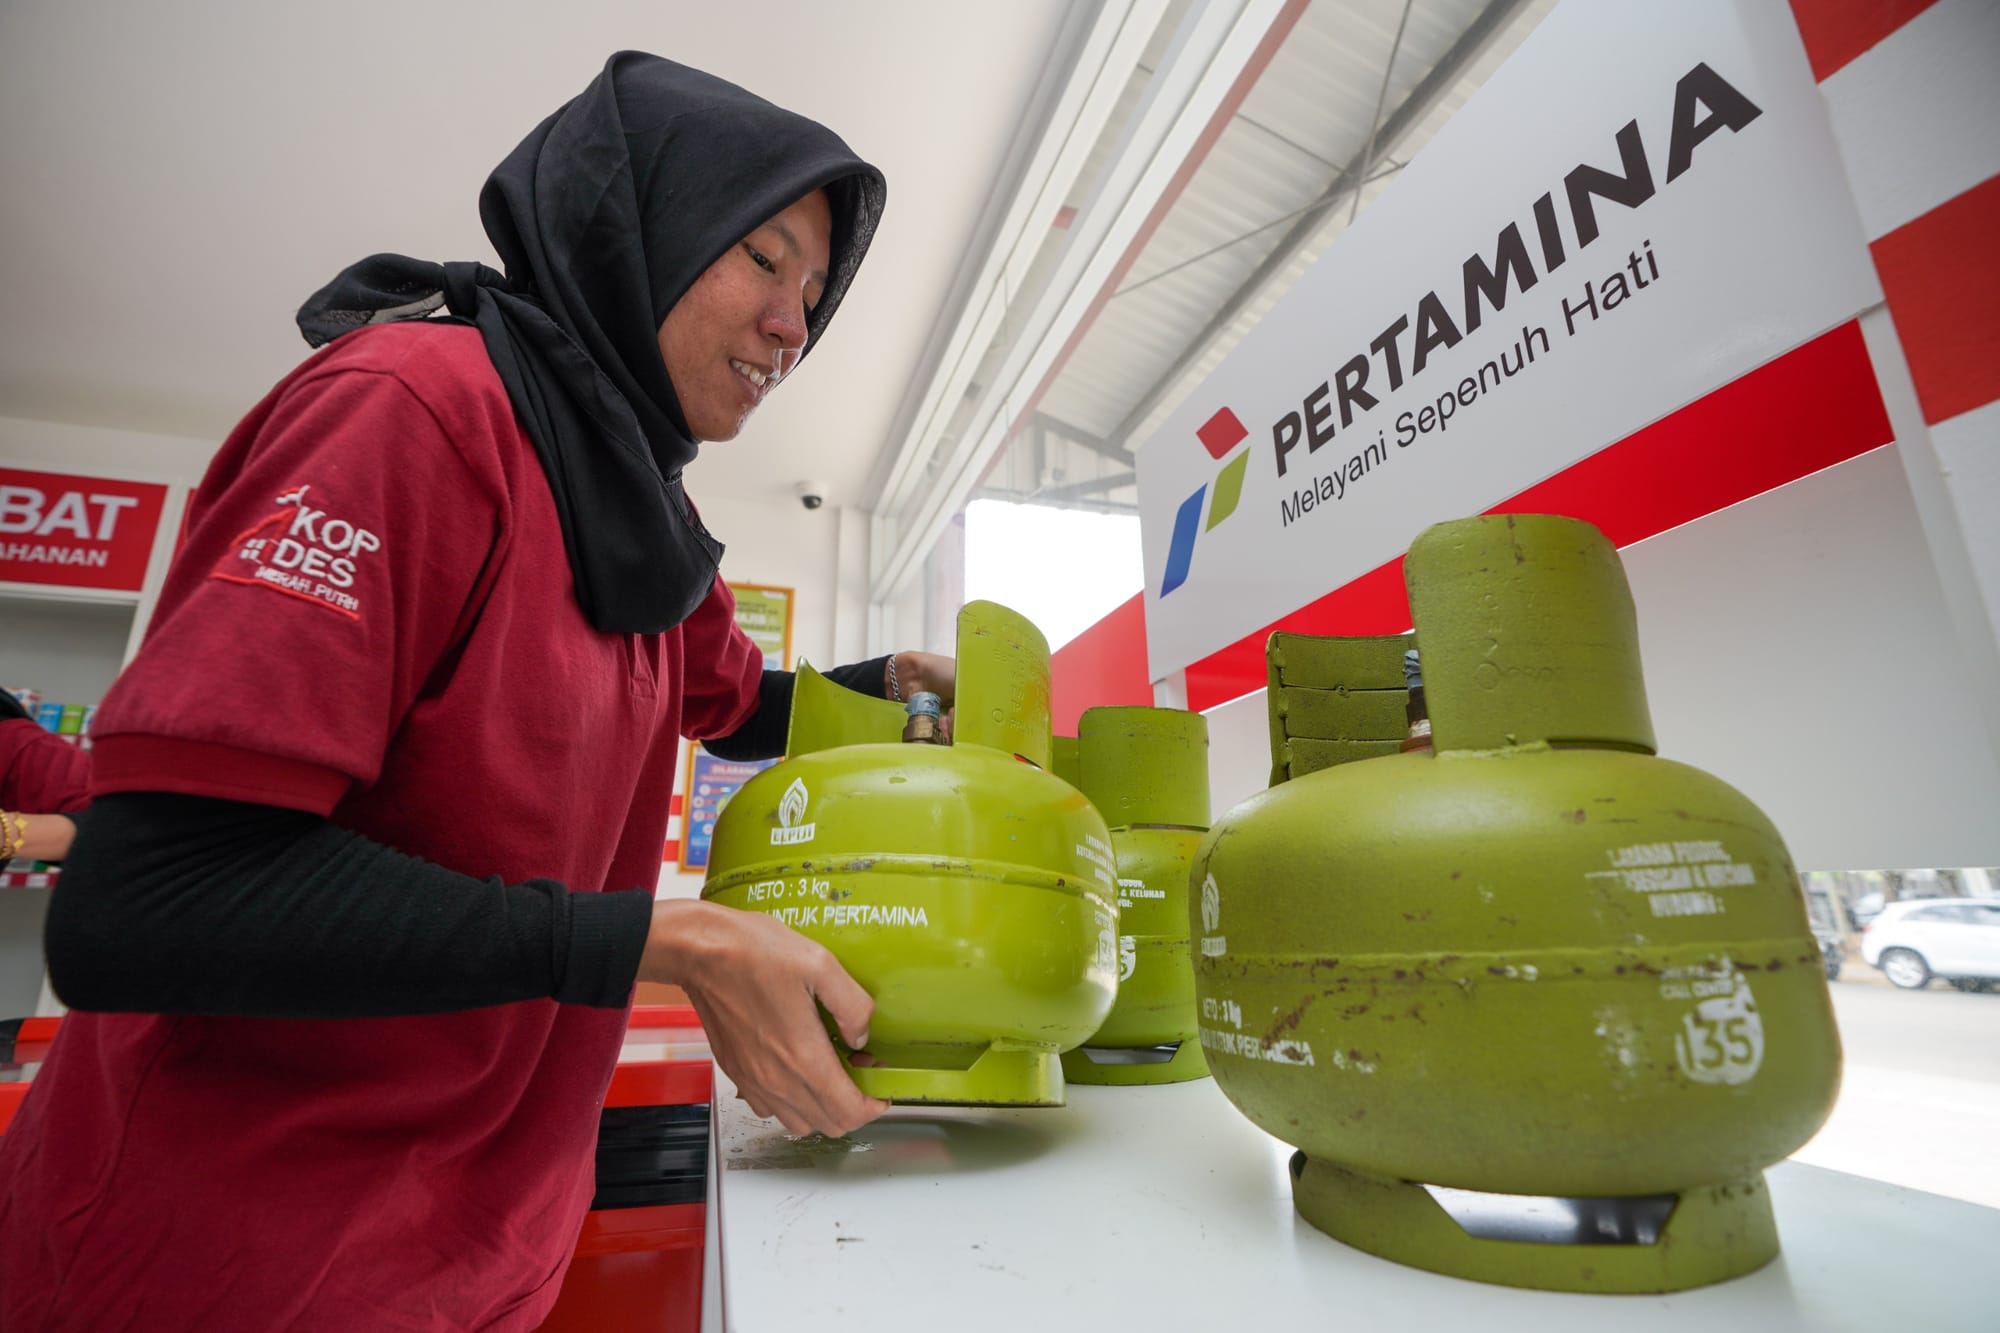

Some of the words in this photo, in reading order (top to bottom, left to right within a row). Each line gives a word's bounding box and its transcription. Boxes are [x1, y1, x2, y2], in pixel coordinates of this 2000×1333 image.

[1271, 62, 1763, 478] PERTAMINA
[1281, 431, 1387, 526] Melayani
[1395, 326, 1550, 448] Sepenuh
[1561, 240, 1660, 336] Hati
[289, 506, 381, 557] KOP
[271, 538, 357, 588] DES
[748, 880, 785, 902] NETO
[797, 878, 807, 897] 3
[811, 877, 830, 899] kg
[822, 904, 929, 928] PERTAMINA
